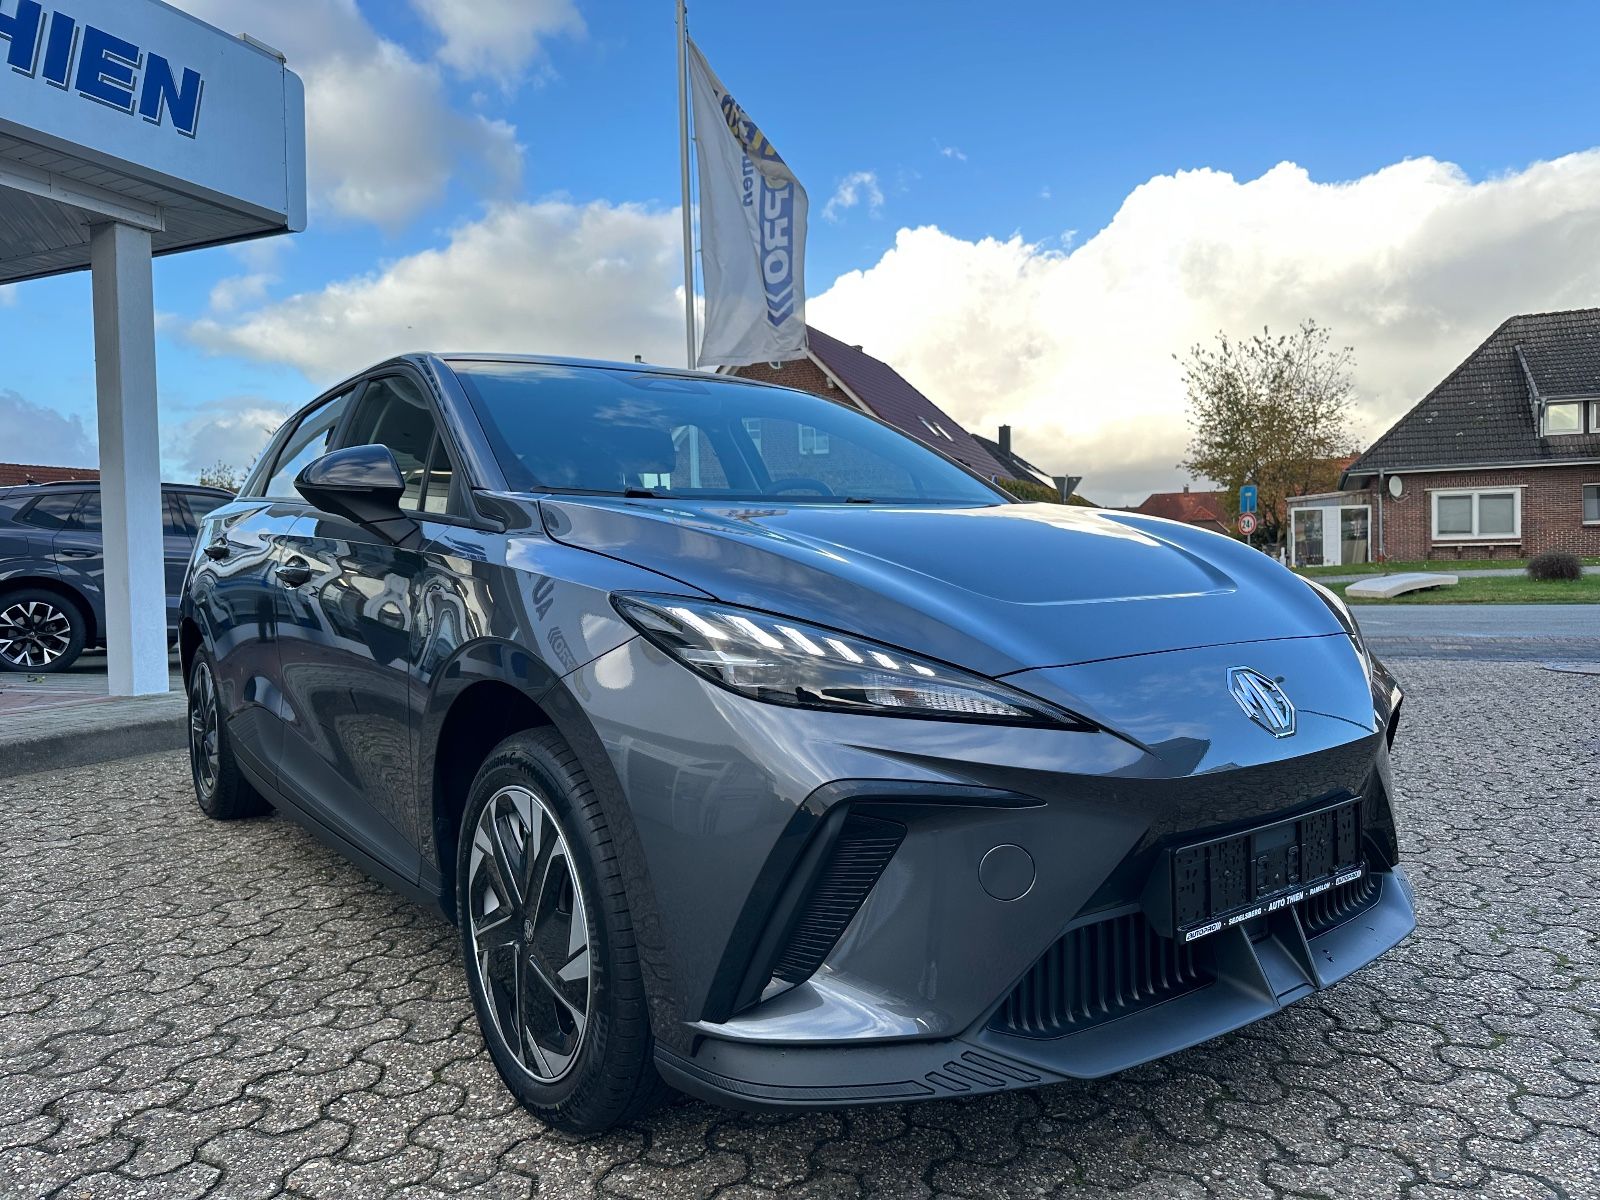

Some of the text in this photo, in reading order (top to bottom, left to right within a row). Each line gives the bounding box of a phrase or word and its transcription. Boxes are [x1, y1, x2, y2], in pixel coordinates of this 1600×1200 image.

[1232, 671, 1292, 731] MG
[1268, 898, 1286, 912] AUTO
[1286, 891, 1304, 905] THIEN
